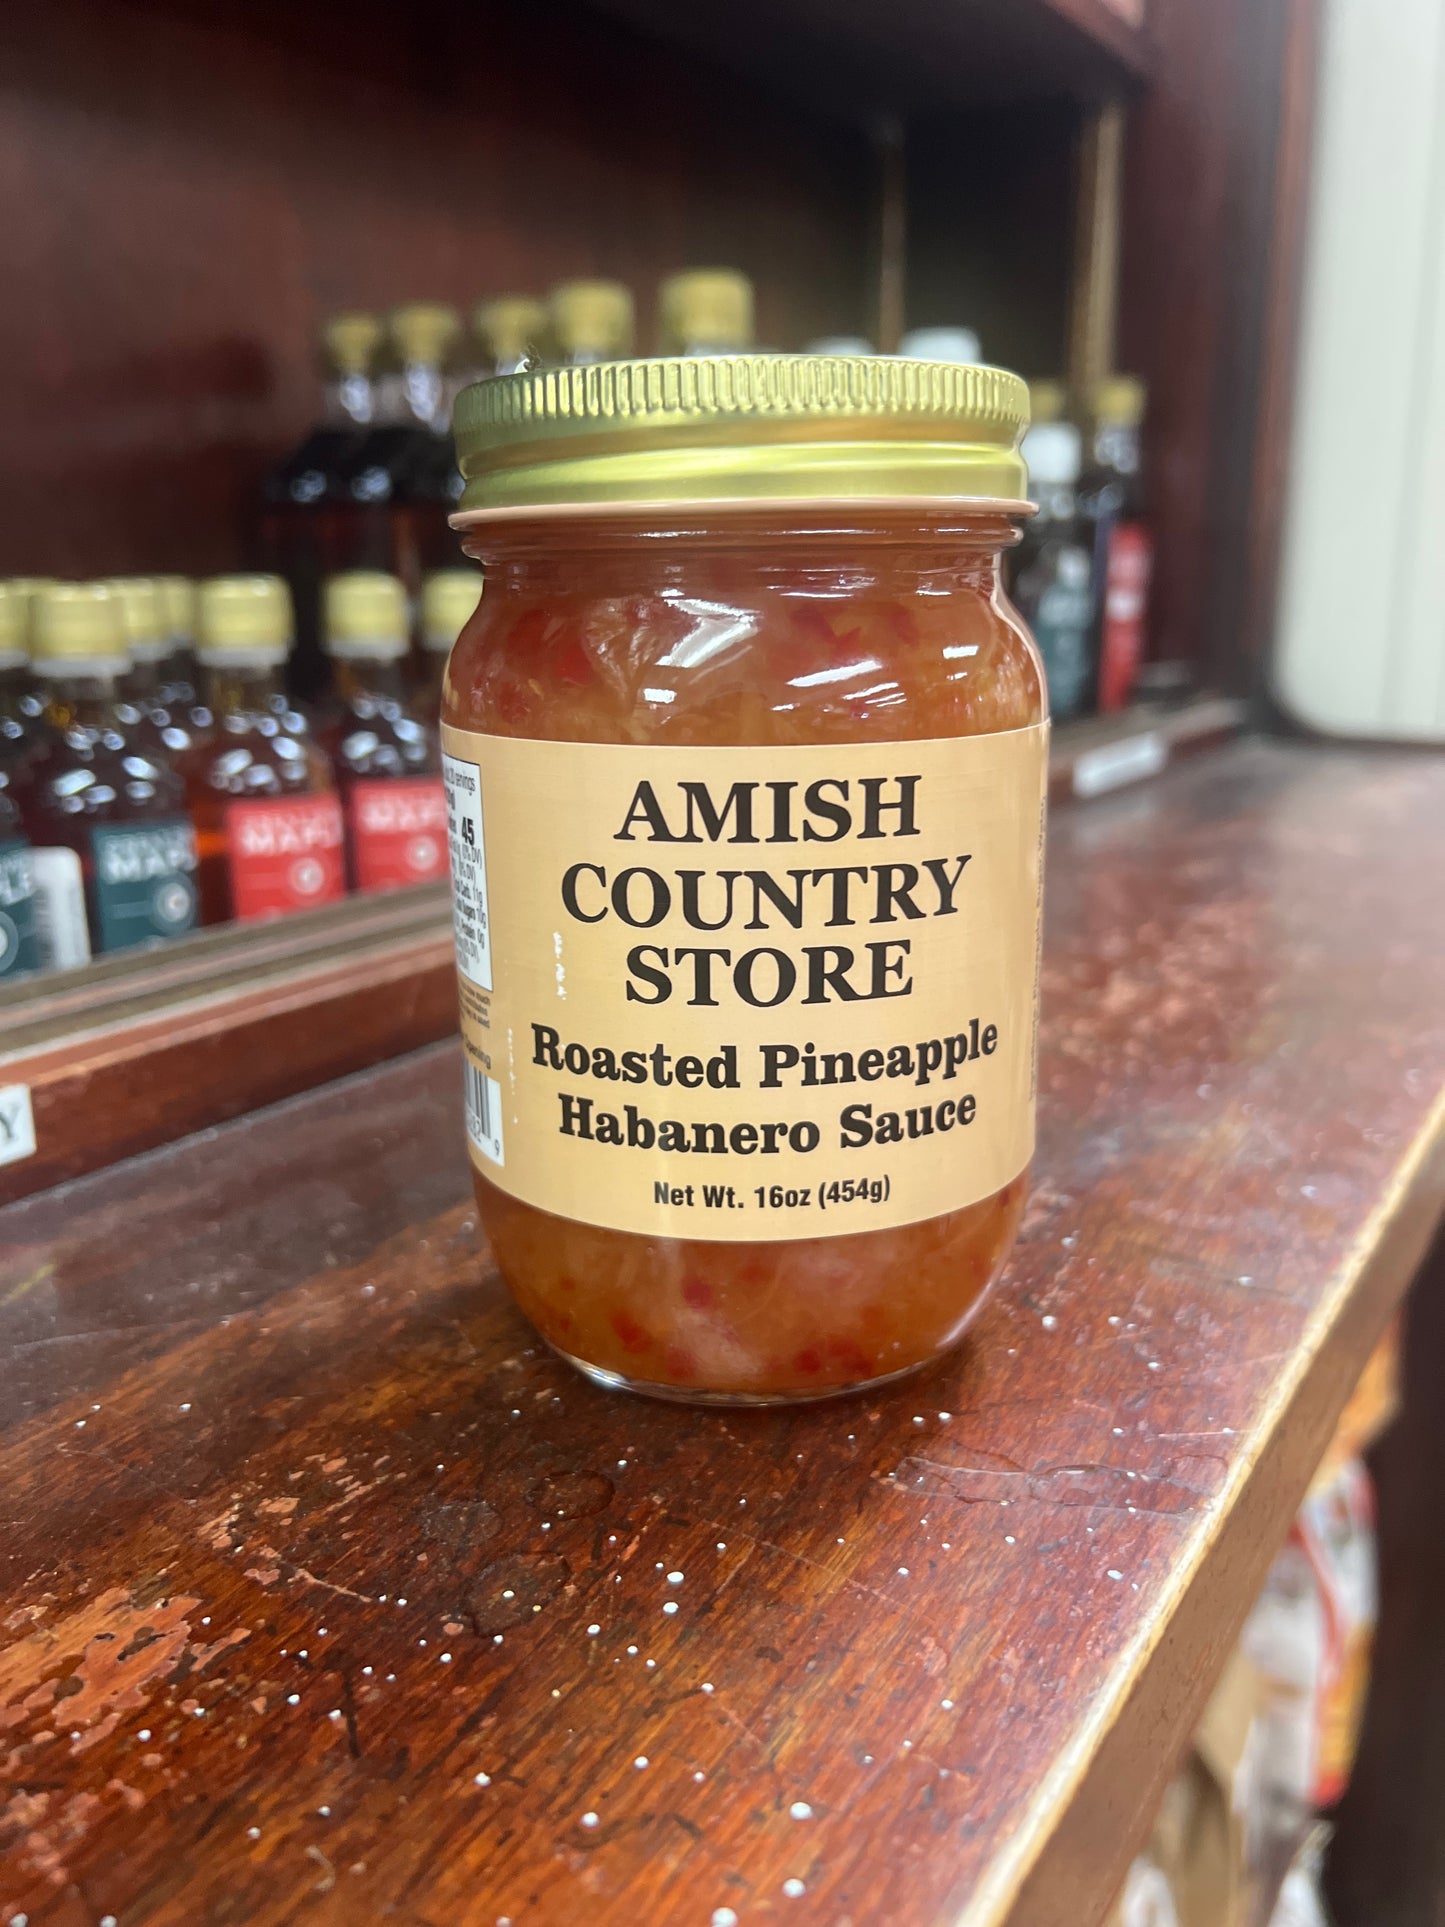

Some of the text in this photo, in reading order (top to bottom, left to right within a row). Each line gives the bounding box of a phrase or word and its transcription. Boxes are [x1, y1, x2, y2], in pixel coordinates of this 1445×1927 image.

[461, 815, 475, 846] 45
[612, 774, 922, 844] AMISH
[561, 854, 973, 931] COUNTRY
[625, 939, 913, 1008] STORE
[530, 1017, 999, 1090] Roasted Pineapple
[557, 1092, 976, 1155] Habanero Sauce
[654, 1174, 891, 1210] Net Wt. 16oz (454g)
